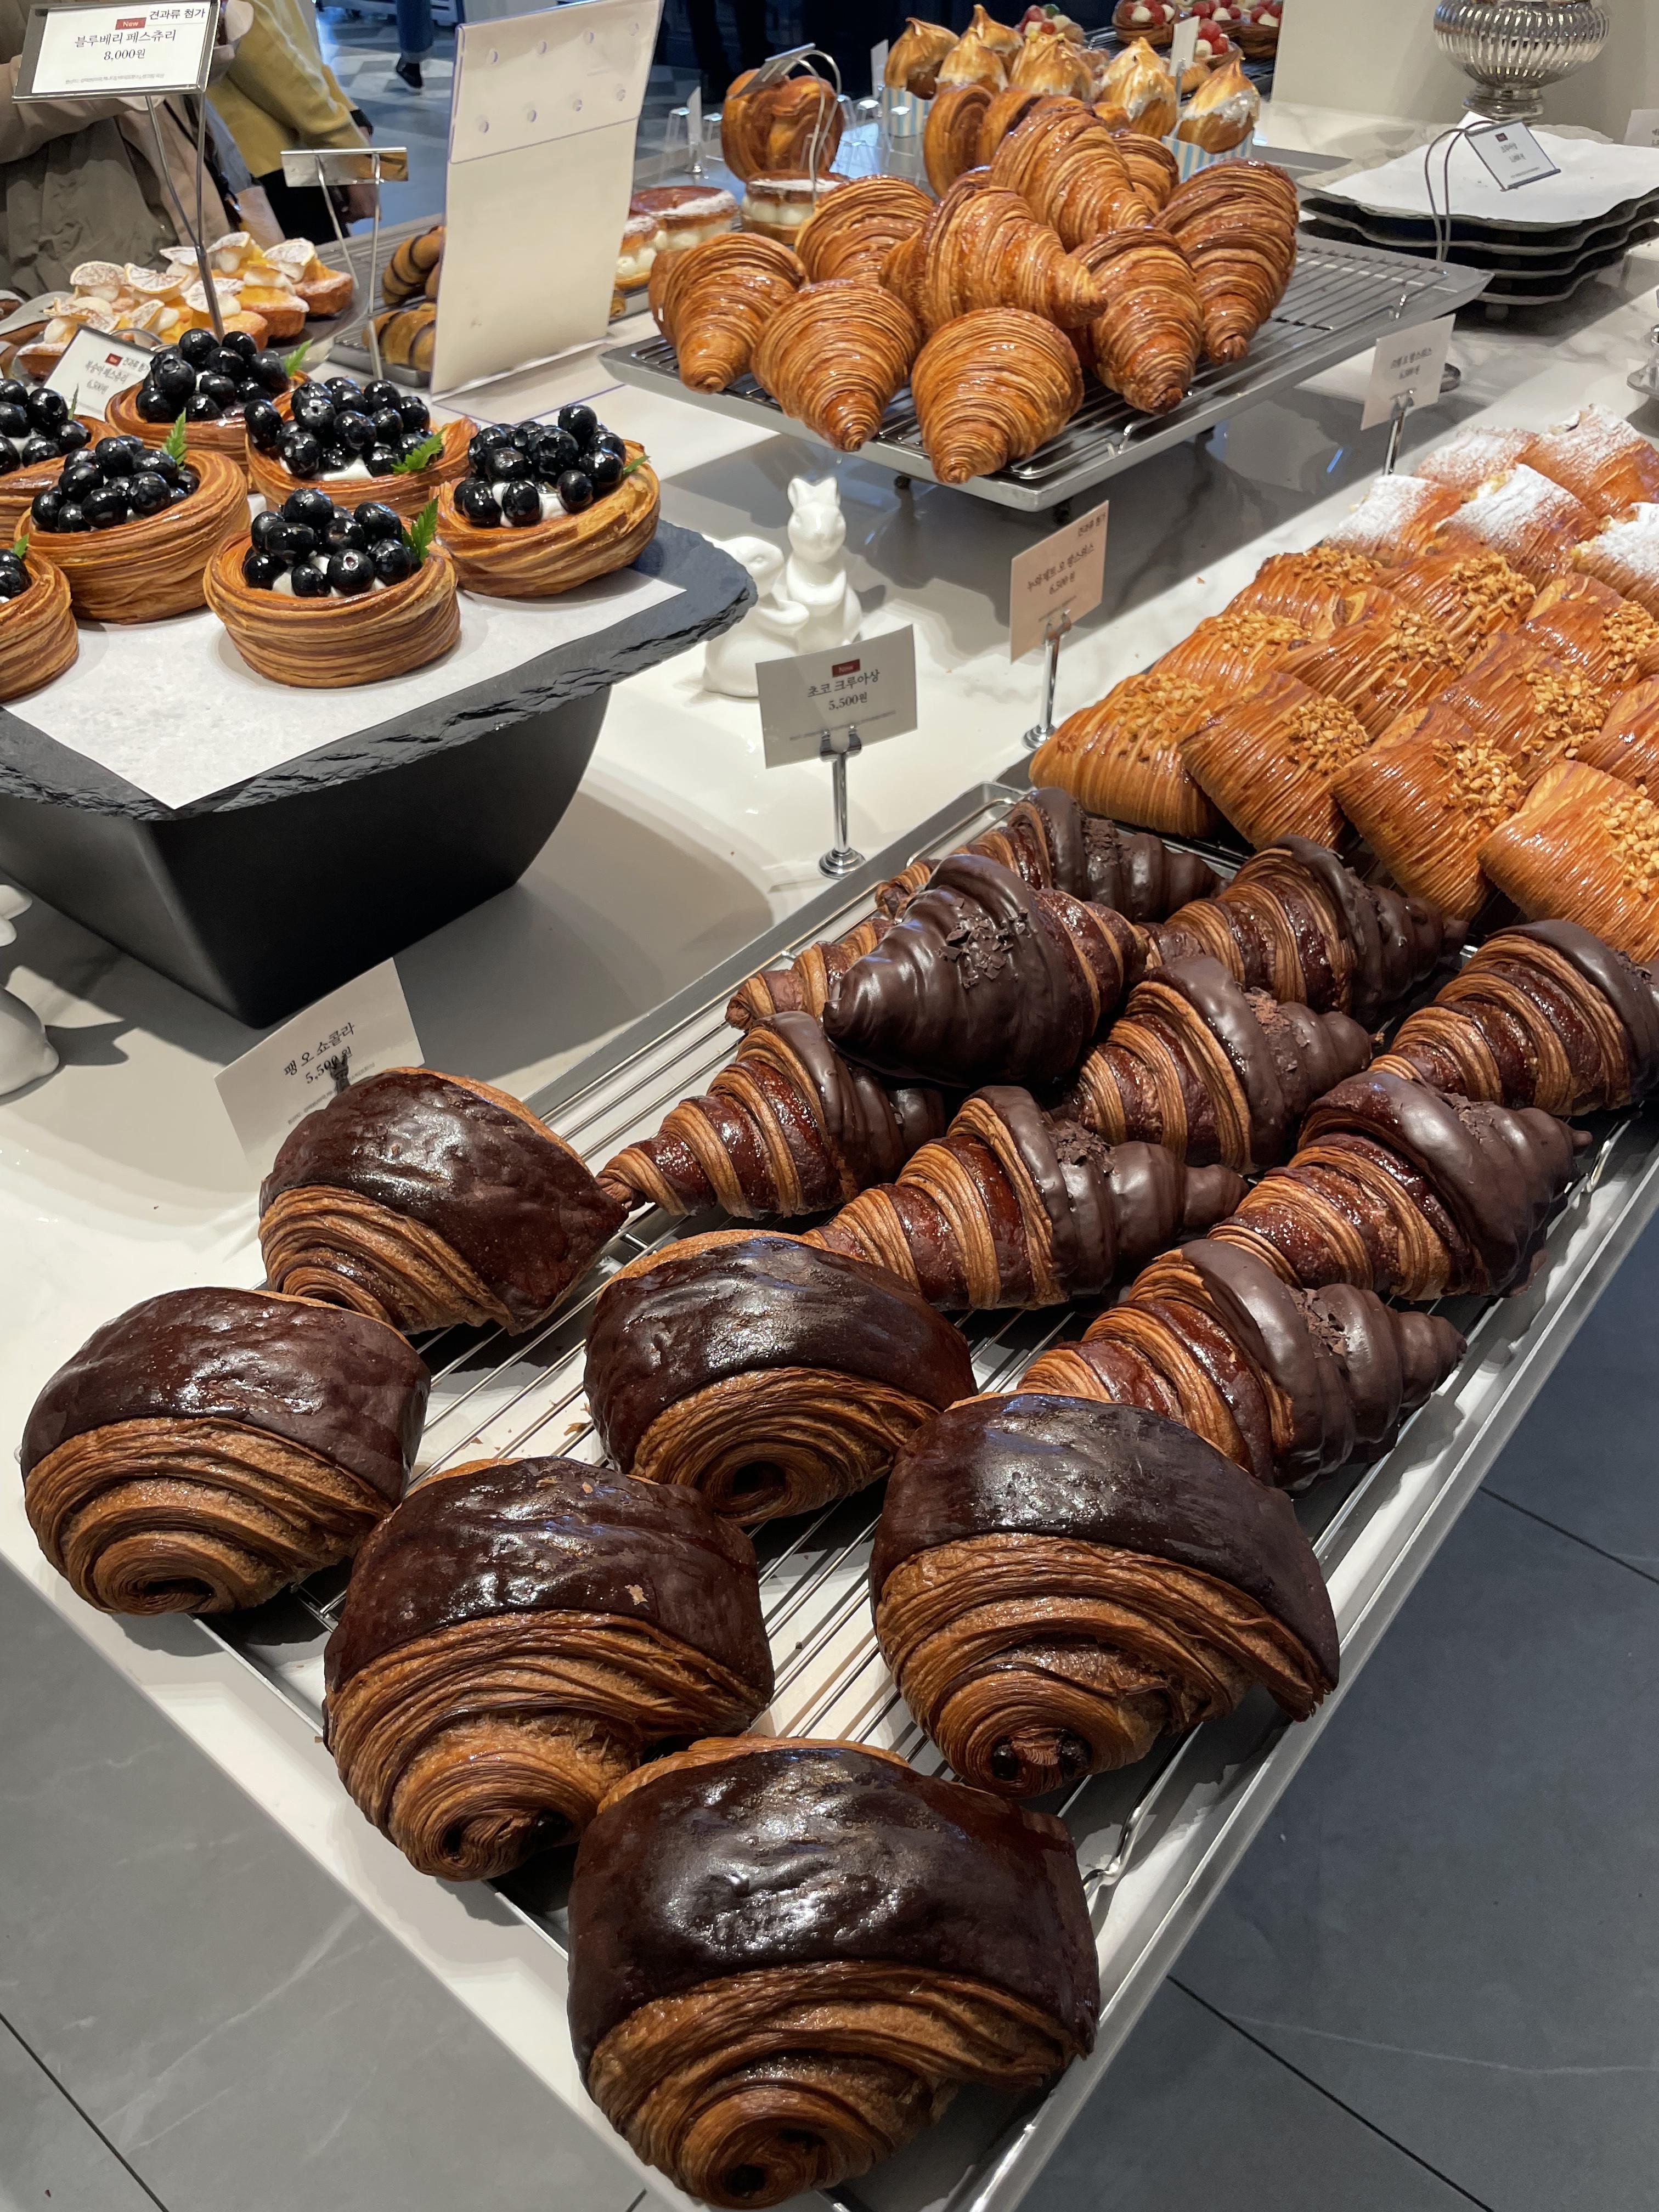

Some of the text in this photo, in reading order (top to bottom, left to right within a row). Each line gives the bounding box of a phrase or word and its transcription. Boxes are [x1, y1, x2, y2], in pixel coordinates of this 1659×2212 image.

[149, 8, 206, 20] 견과류 첨가
[75, 30, 176, 48] 블루베리 페스츄리
[104, 49, 145, 62] 8,000원
[808, 669, 881, 698] 초코 크루아상
[828, 692, 868, 711] 5,500원
[301, 1052, 314, 1067] 오
[317, 1022, 355, 1054] 쇼콜라
